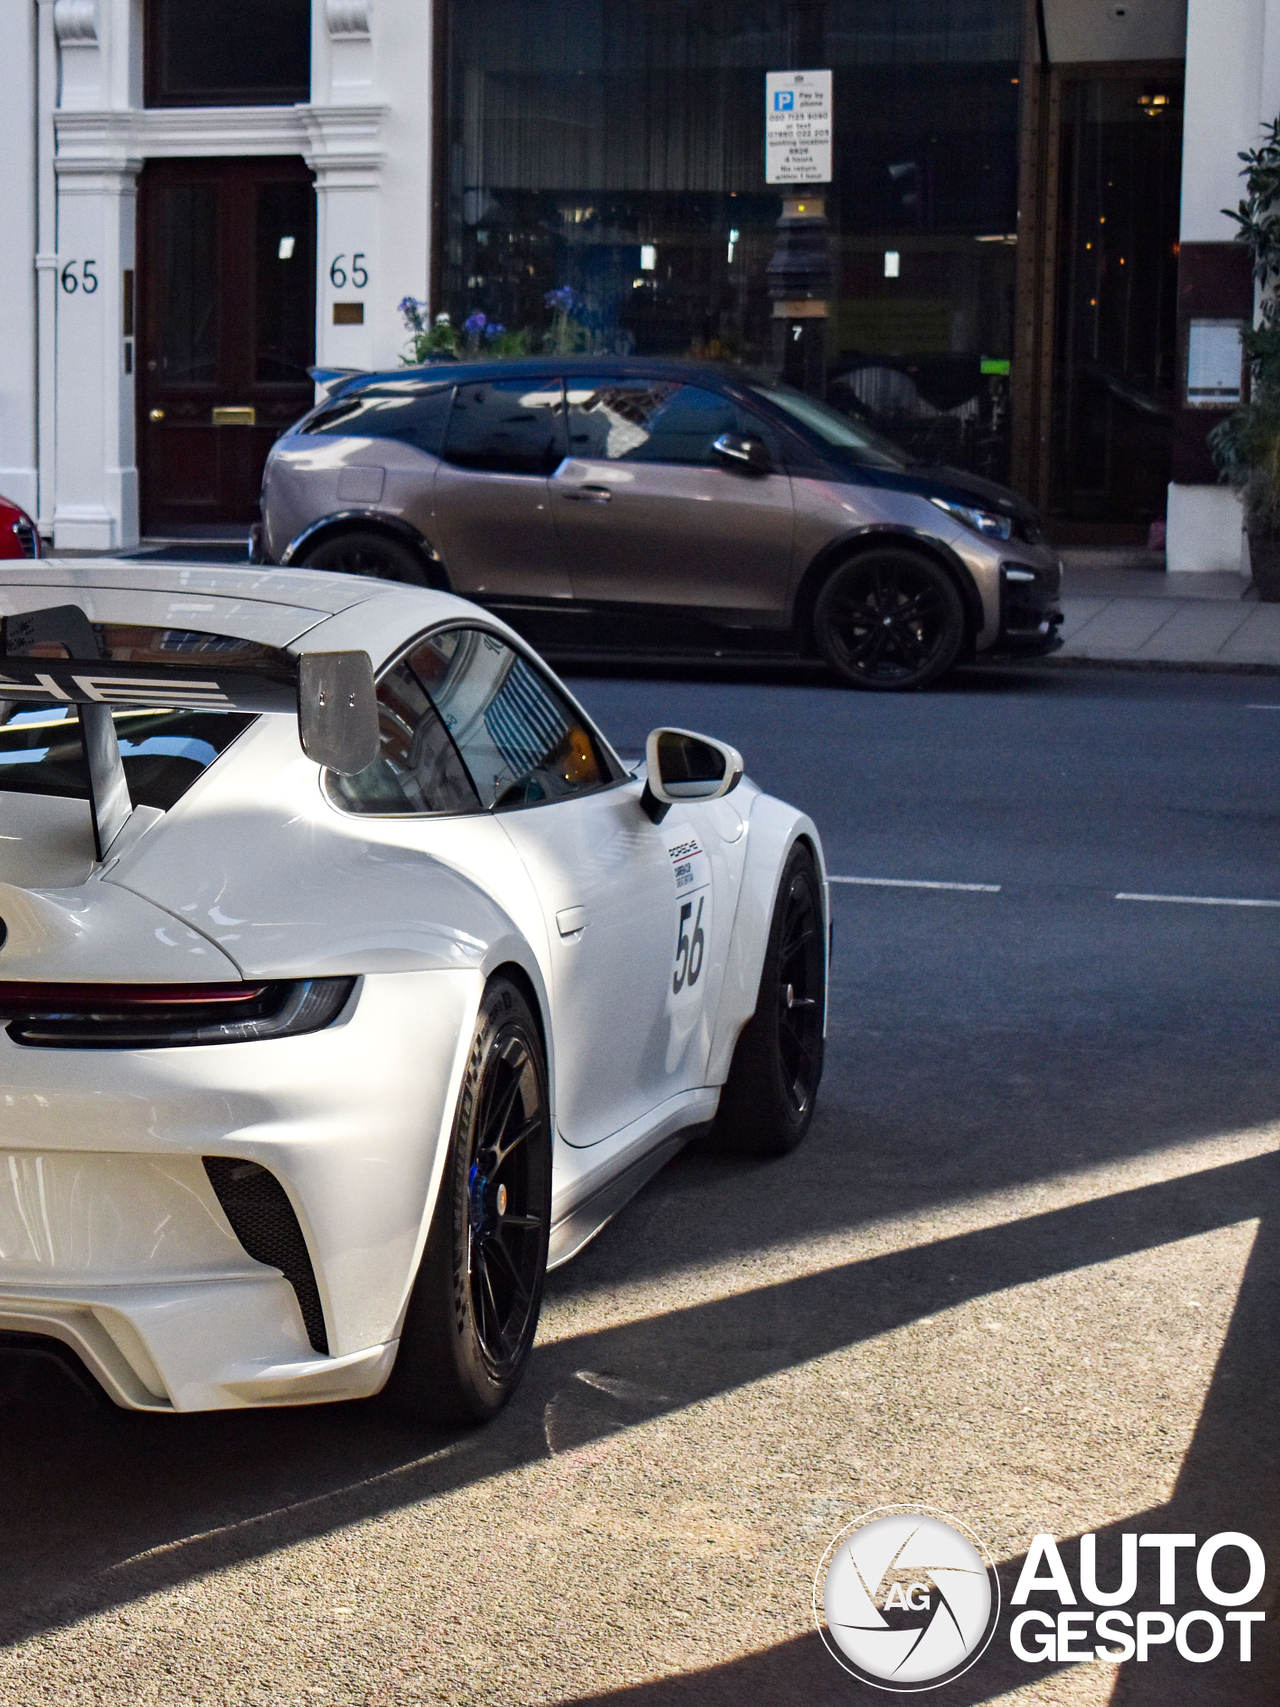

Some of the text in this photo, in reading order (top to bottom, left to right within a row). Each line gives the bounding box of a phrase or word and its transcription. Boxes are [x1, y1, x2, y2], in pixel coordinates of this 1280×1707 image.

[61, 260, 98, 294] 65
[329, 253, 368, 288] 65
[792, 325, 803, 341] 7
[668, 840, 698, 857] PORSCHE
[673, 896, 704, 995] 56
